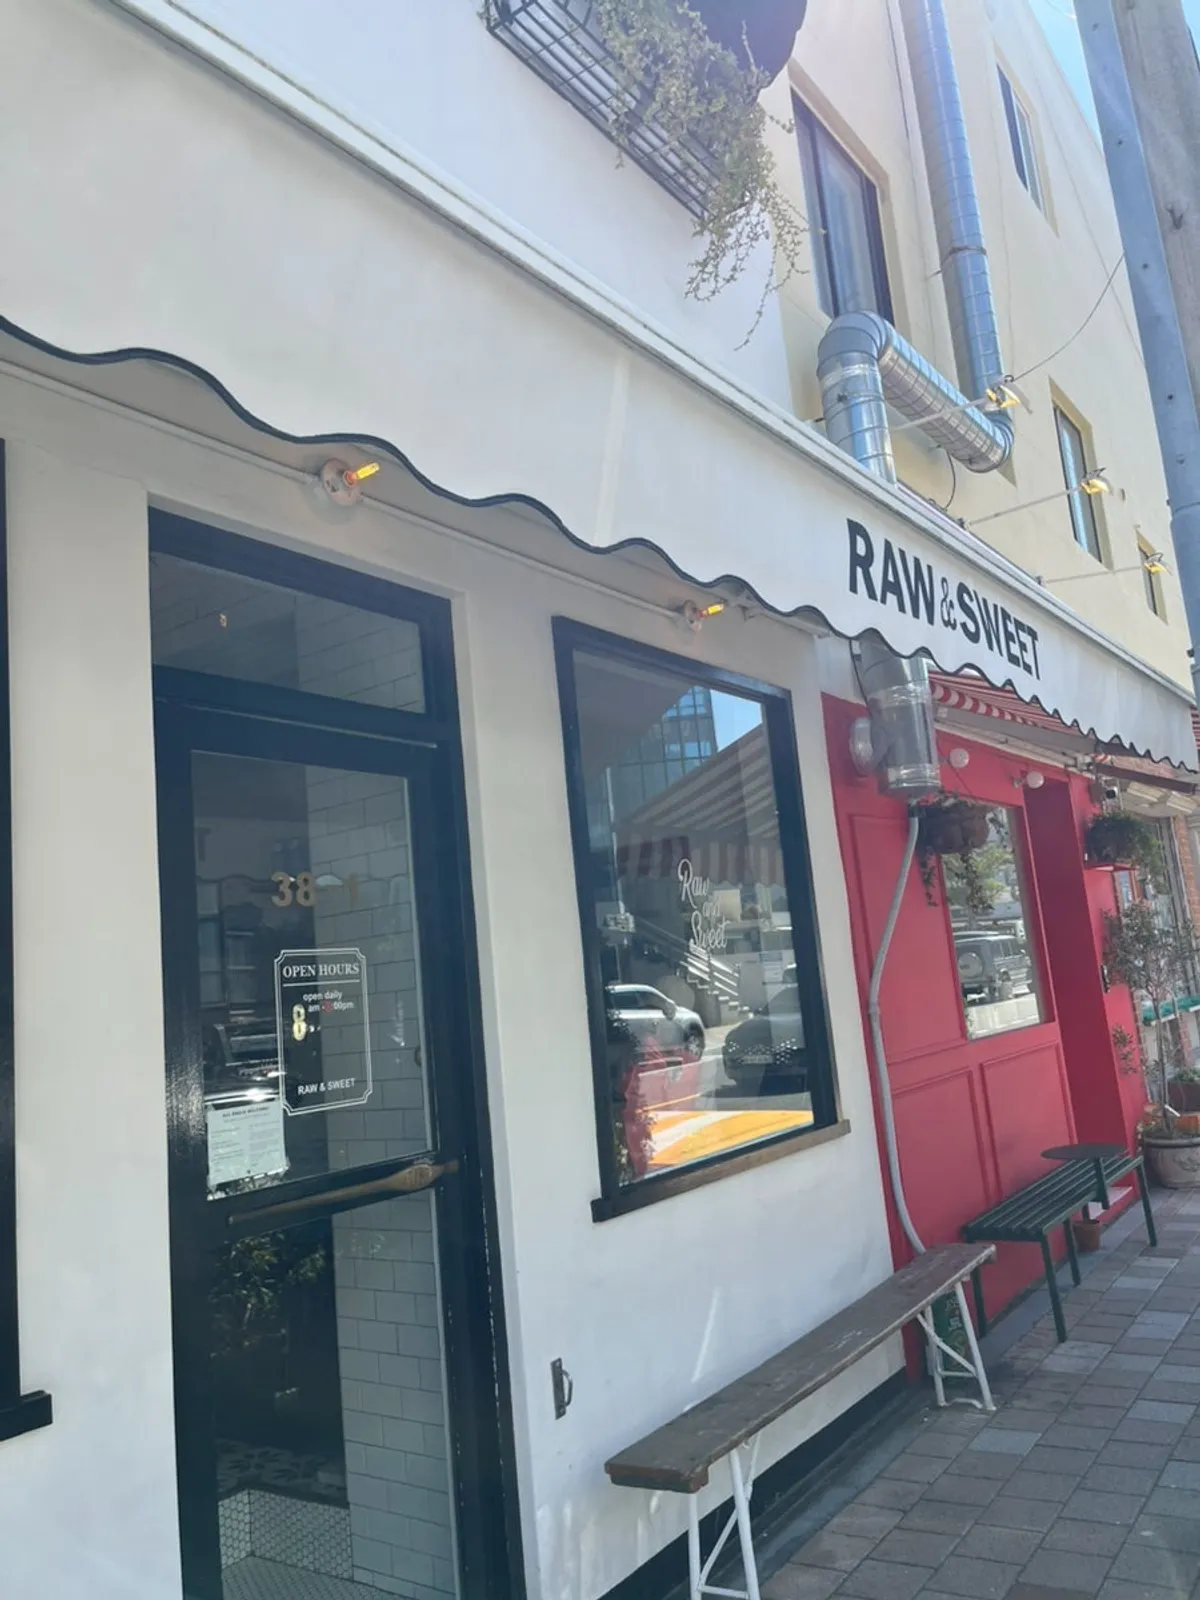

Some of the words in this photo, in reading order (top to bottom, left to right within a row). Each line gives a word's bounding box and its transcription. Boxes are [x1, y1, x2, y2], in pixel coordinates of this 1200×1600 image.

[846, 518, 935, 626] RAW
[956, 581, 1041, 680] SWEET
[271, 871, 316, 907] 38
[678, 858, 711, 909] Raw
[282, 964, 316, 978] OPEN
[318, 962, 360, 976] HOURS
[324, 990, 342, 1001] daily
[298, 1083, 318, 1095] RAW
[327, 1077, 355, 1091] SWEET
